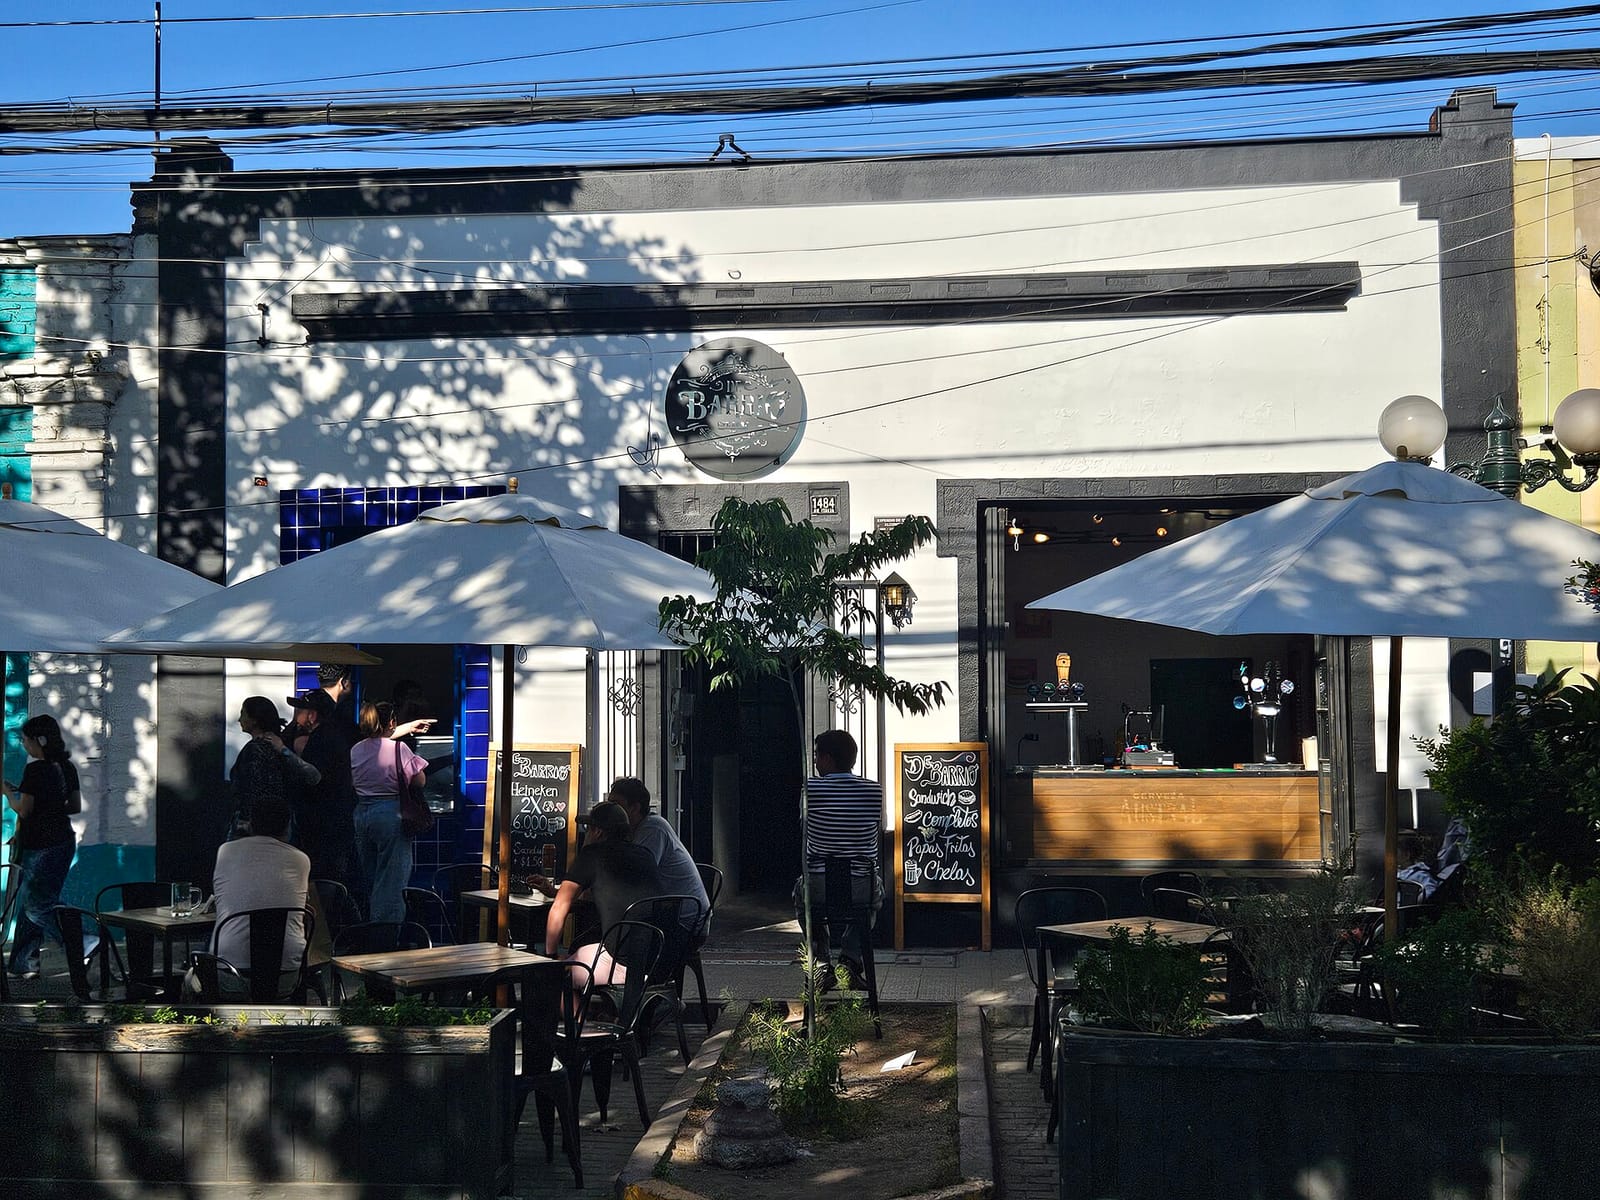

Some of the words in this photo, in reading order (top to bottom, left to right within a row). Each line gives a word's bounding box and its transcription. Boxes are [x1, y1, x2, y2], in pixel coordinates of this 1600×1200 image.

[812, 497, 835, 509] 1484
[513, 756, 571, 781] BARRIO
[920, 761, 979, 787] BARRIO
[511, 781, 558, 797] Heineken
[908, 788, 957, 808] Sandwich
[1132, 791, 1185, 800] CERVEZA
[512, 814, 547, 831] 6.000
[922, 805, 978, 835] Completos
[906, 835, 944, 863] Papas
[939, 834, 976, 863] Fritas
[924, 860, 976, 886] Chelas
